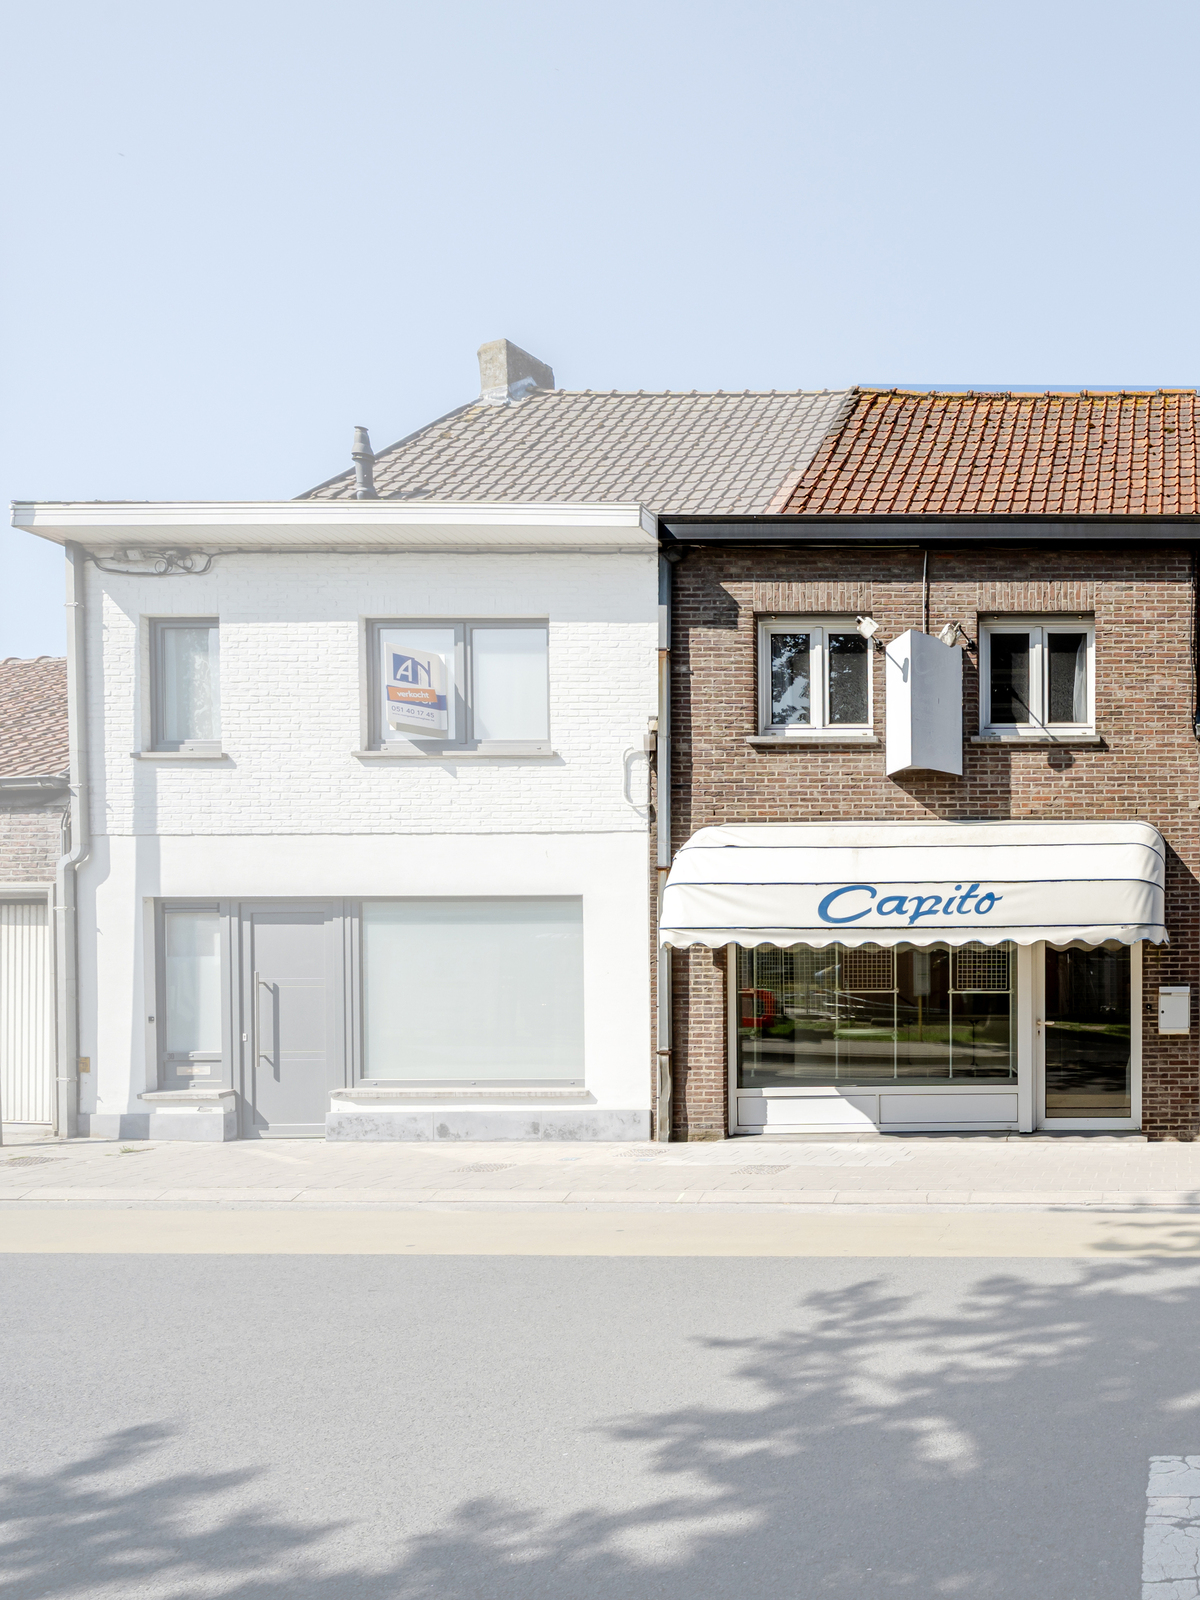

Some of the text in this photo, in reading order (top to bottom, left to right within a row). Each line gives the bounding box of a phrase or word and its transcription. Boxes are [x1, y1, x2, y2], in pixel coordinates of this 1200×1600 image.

[396, 690, 430, 699] verkocht
[391, 705, 404, 713] 051
[426, 711, 435, 719] 45
[817, 882, 1003, 926] Capito
